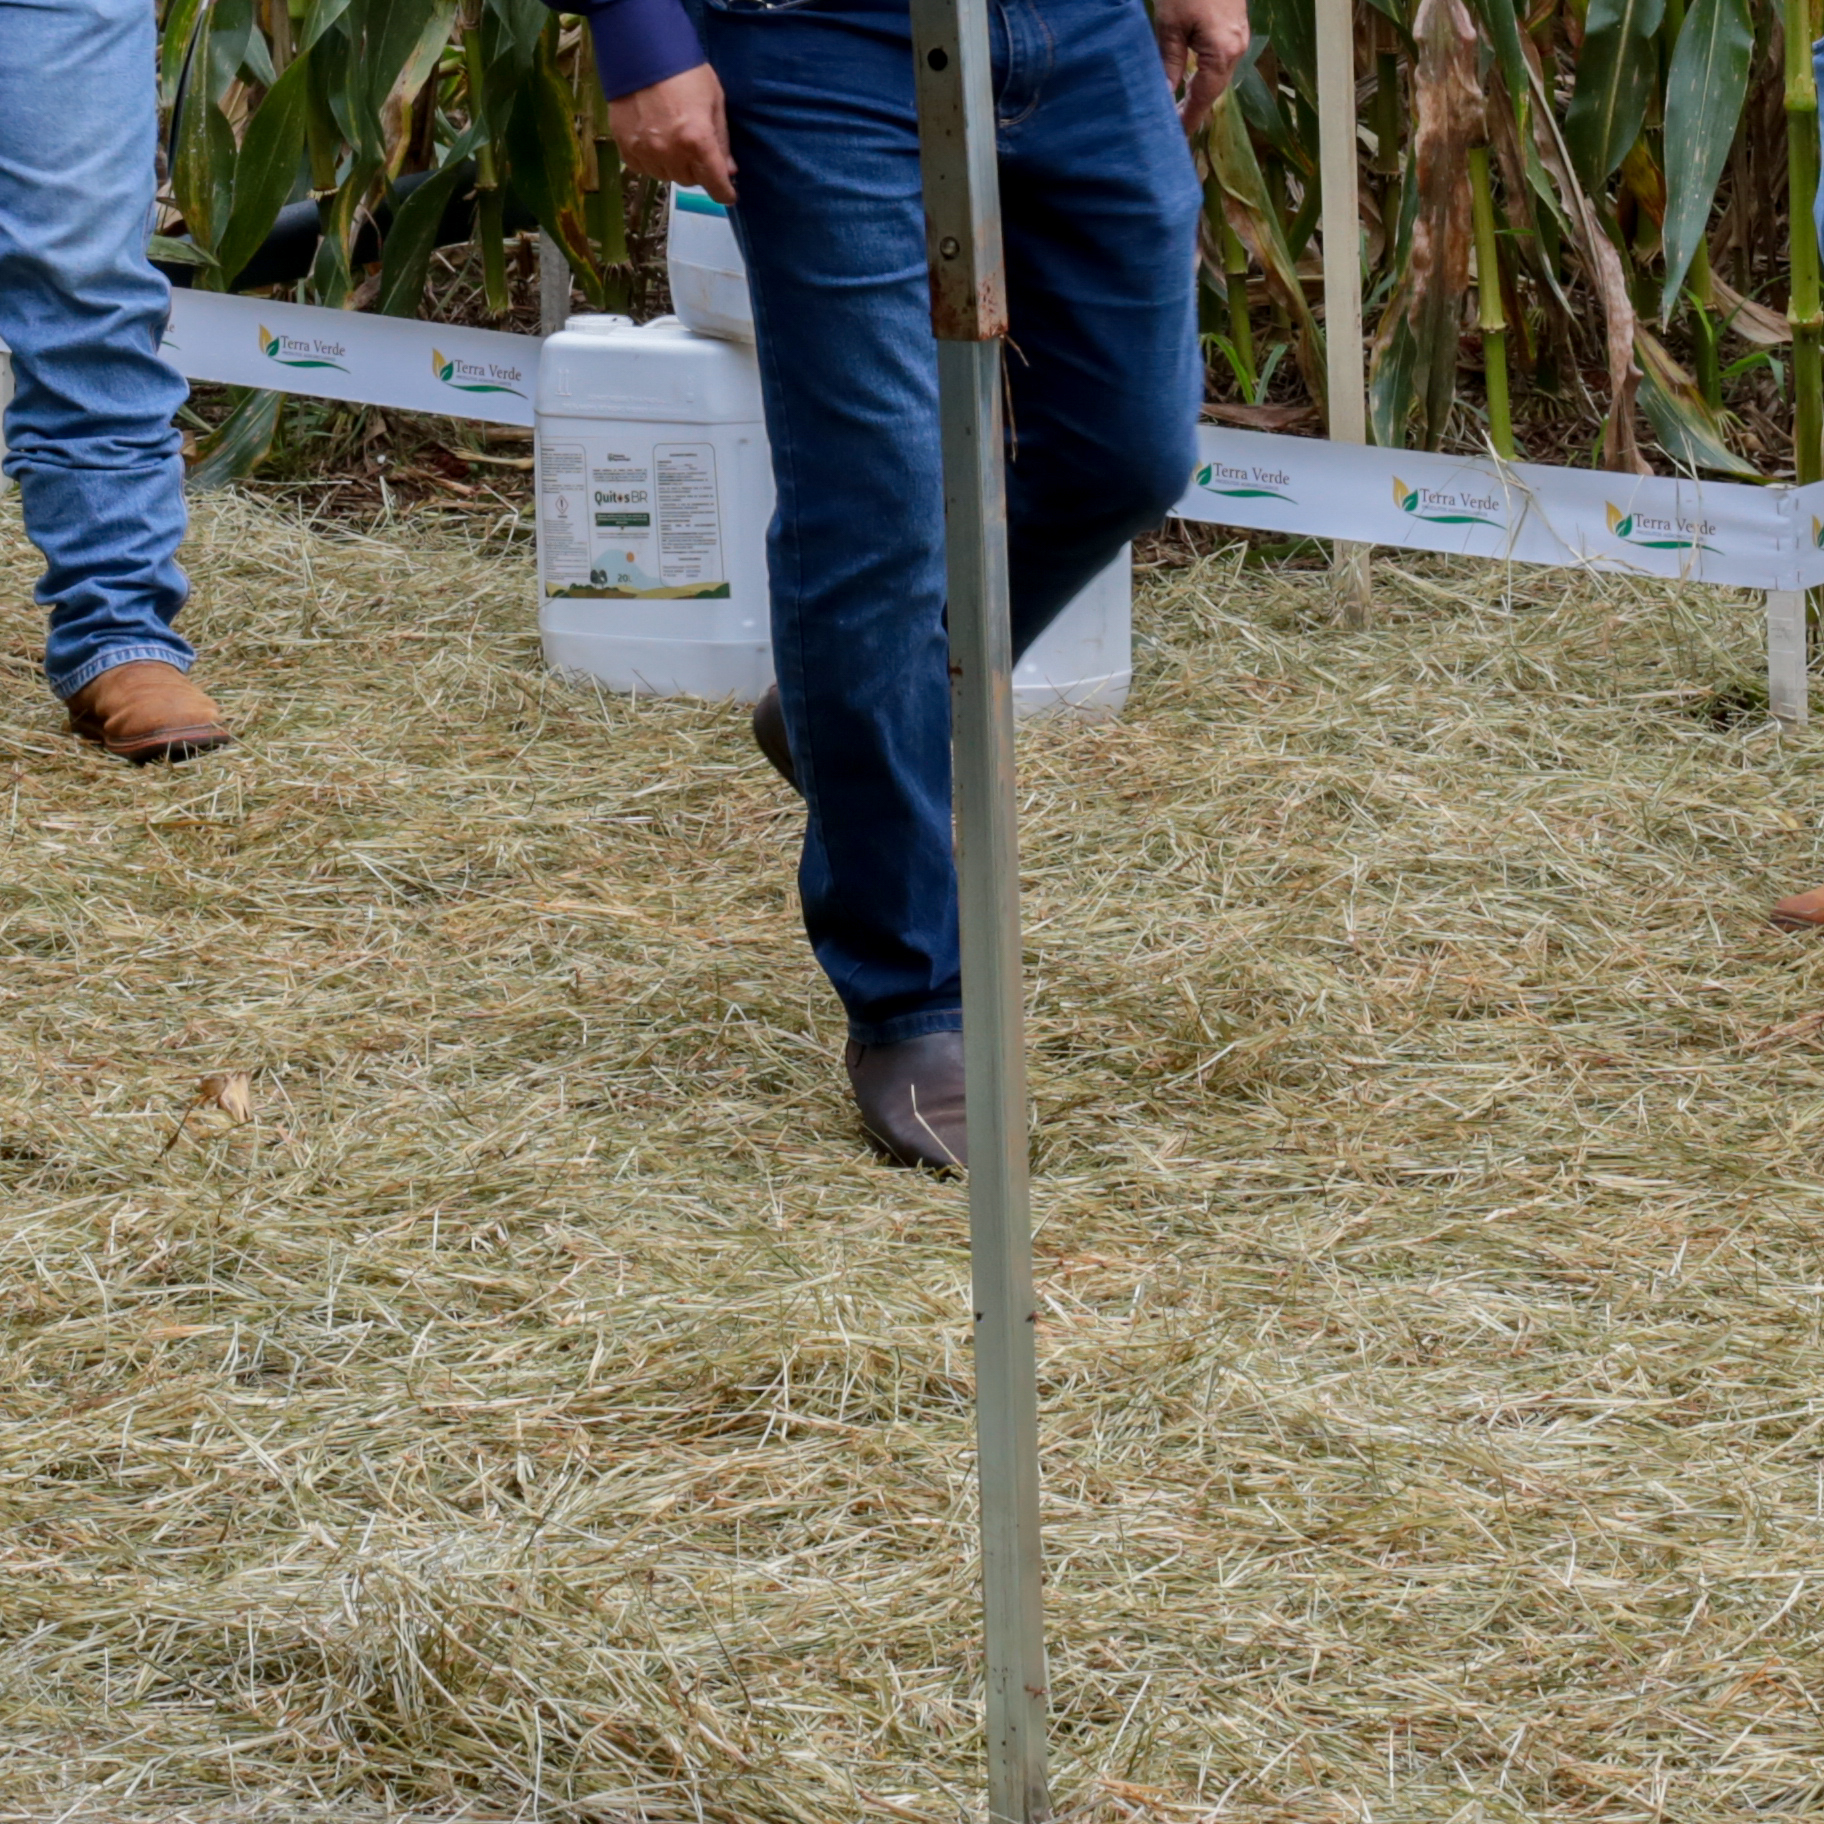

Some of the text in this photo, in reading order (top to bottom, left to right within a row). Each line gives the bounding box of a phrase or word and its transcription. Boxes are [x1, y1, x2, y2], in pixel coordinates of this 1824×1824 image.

[280, 335, 310, 352] Terra
[313, 339, 346, 356] Verde
[454, 359, 485, 376] Terra
[489, 364, 522, 381] Verde
[1213, 462, 1290, 486] Terra Verde
[1419, 488, 1499, 511] Terra Verde
[1633, 513, 1671, 530] Terra
